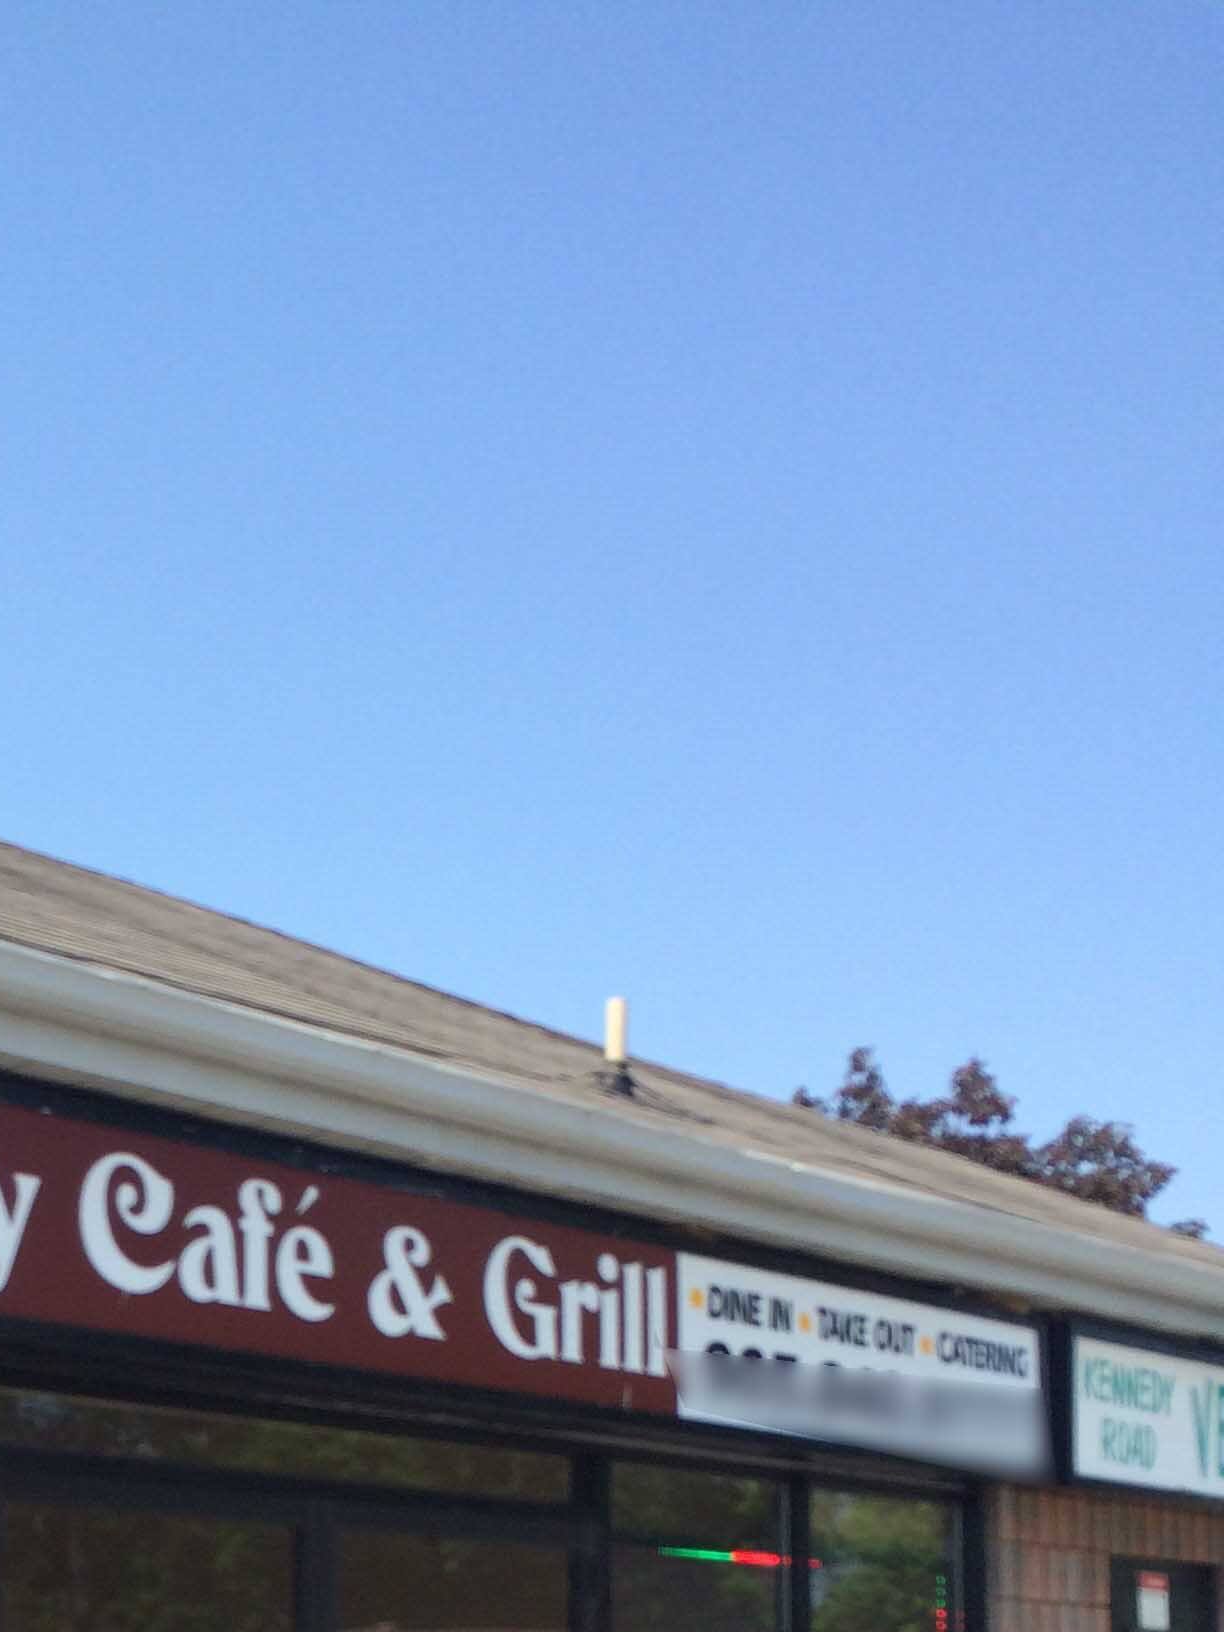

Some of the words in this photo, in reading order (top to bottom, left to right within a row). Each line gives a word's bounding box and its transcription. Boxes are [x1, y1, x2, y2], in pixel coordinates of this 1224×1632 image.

[78, 1151, 336, 1323] Café
[367, 1225, 453, 1341] &
[483, 1235, 667, 1378] Grill
[707, 1285, 761, 1327] DINE
[769, 1296, 793, 1333] IN
[816, 1306, 868, 1347] TAKE
[875, 1319, 916, 1356] OUT
[936, 1331, 1028, 1379] CATERING
[1081, 1356, 1175, 1417] KENNEDY
[1100, 1416, 1158, 1473] ROAD
